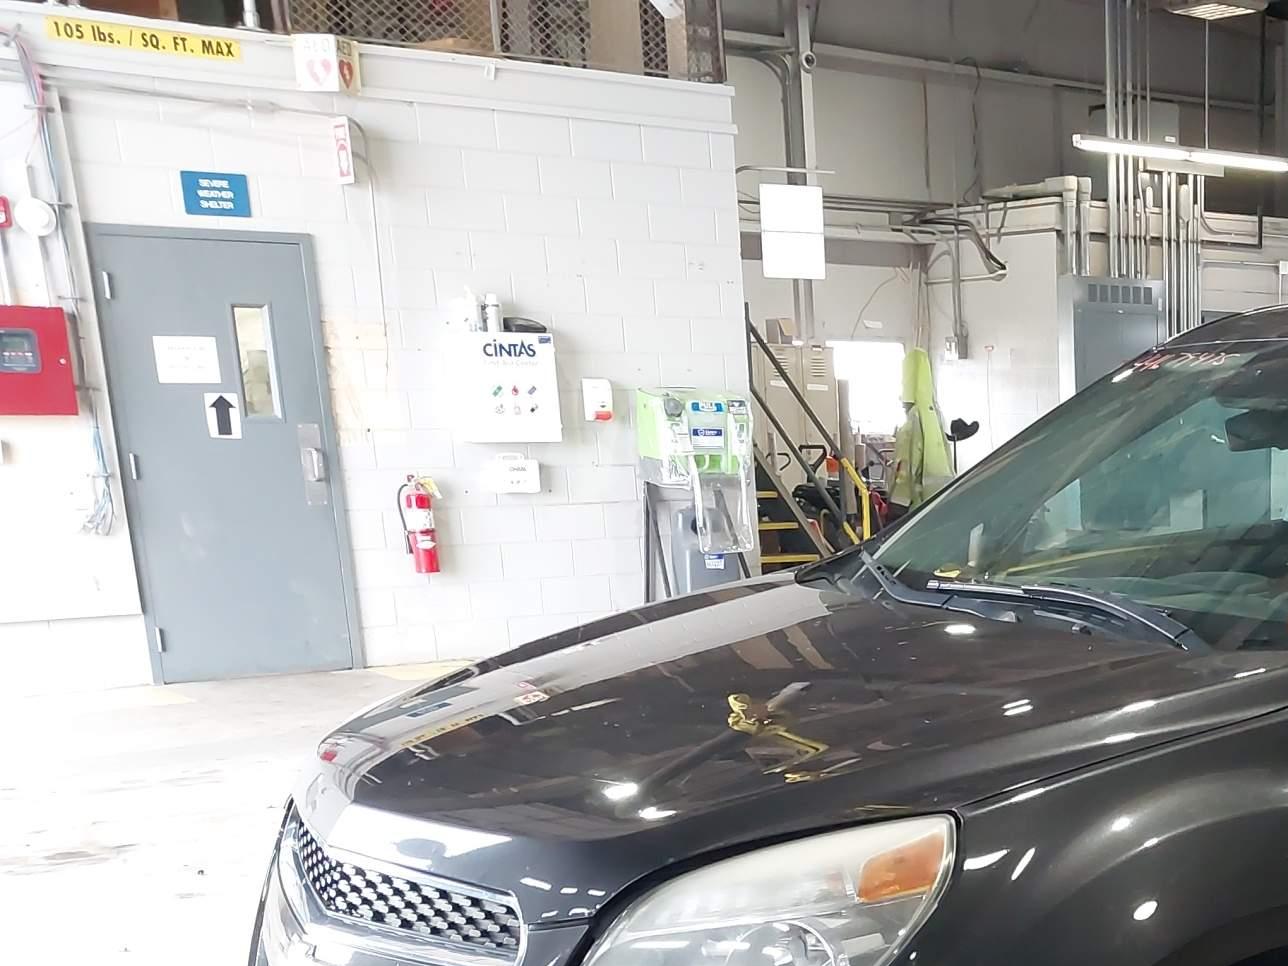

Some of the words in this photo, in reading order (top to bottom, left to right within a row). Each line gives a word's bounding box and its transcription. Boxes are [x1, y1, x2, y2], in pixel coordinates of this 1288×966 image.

[53, 21, 84, 39] 105
[91, 25, 121, 44] lbs.
[141, 33, 166, 50] SQ.
[173, 36, 194, 53] FT.
[201, 39, 235, 57] MAX
